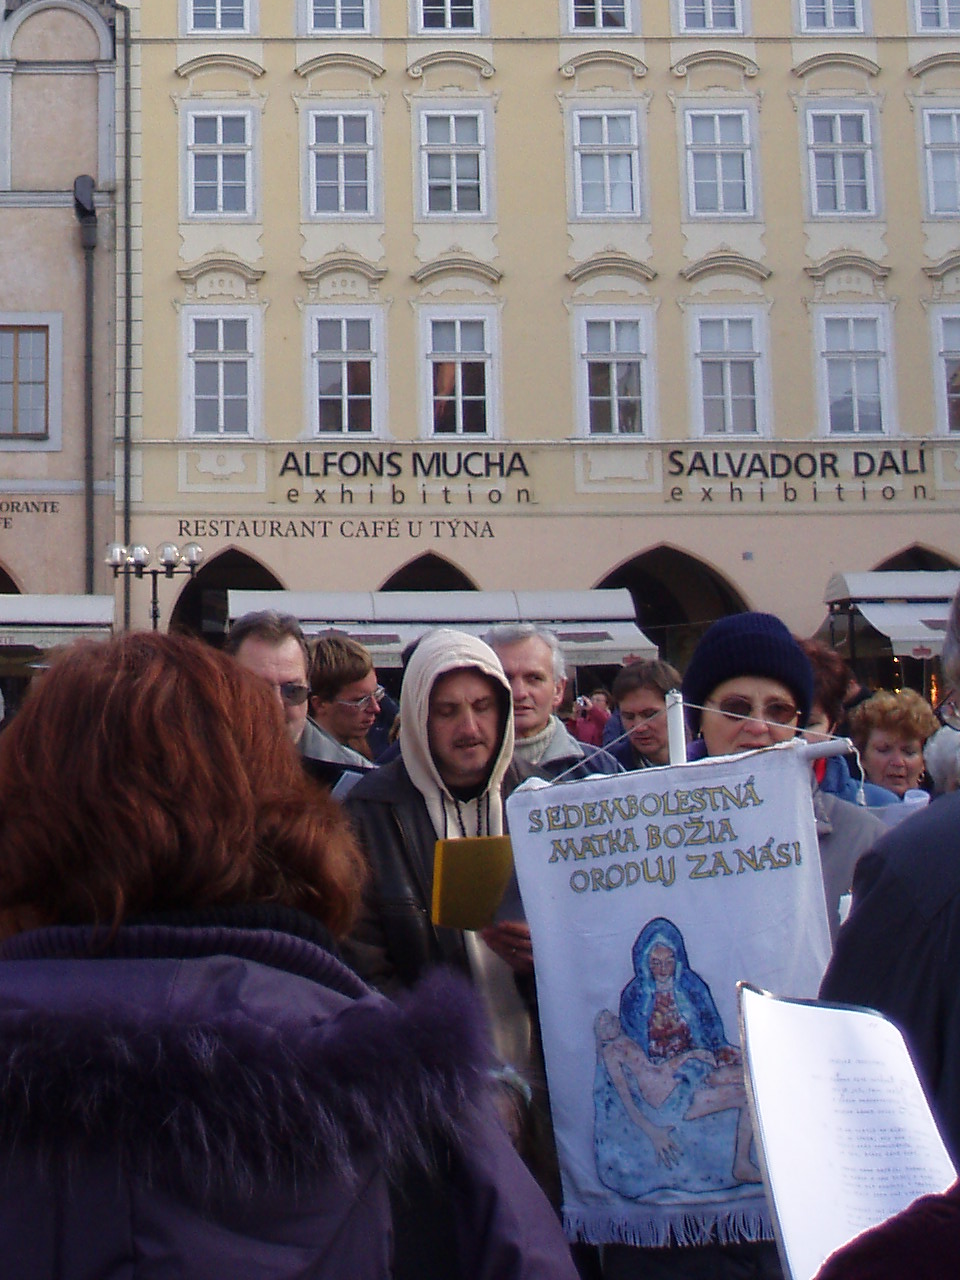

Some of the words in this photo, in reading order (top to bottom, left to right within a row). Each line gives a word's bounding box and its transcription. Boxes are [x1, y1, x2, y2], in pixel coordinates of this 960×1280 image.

[279, 451, 403, 477] ALFONS
[412, 451, 530, 477] MUCHA
[668, 450, 840, 479] SALVADOR
[853, 441, 927, 477] DALÍ
[287, 484, 531, 505] exhibition
[670, 481, 927, 503] exhibition
[178, 520, 333, 537] RESTAURANT
[340, 518, 400, 538] CAFÉ
[408, 521, 423, 538] U
[429, 518, 496, 539] TÝNA
[528, 775, 764, 833] SEDEMBOLESTNÁ
[548, 827, 639, 863] MATKA
[646, 816, 739, 851] BOŽIA
[570, 856, 676, 893] ORODUJ
